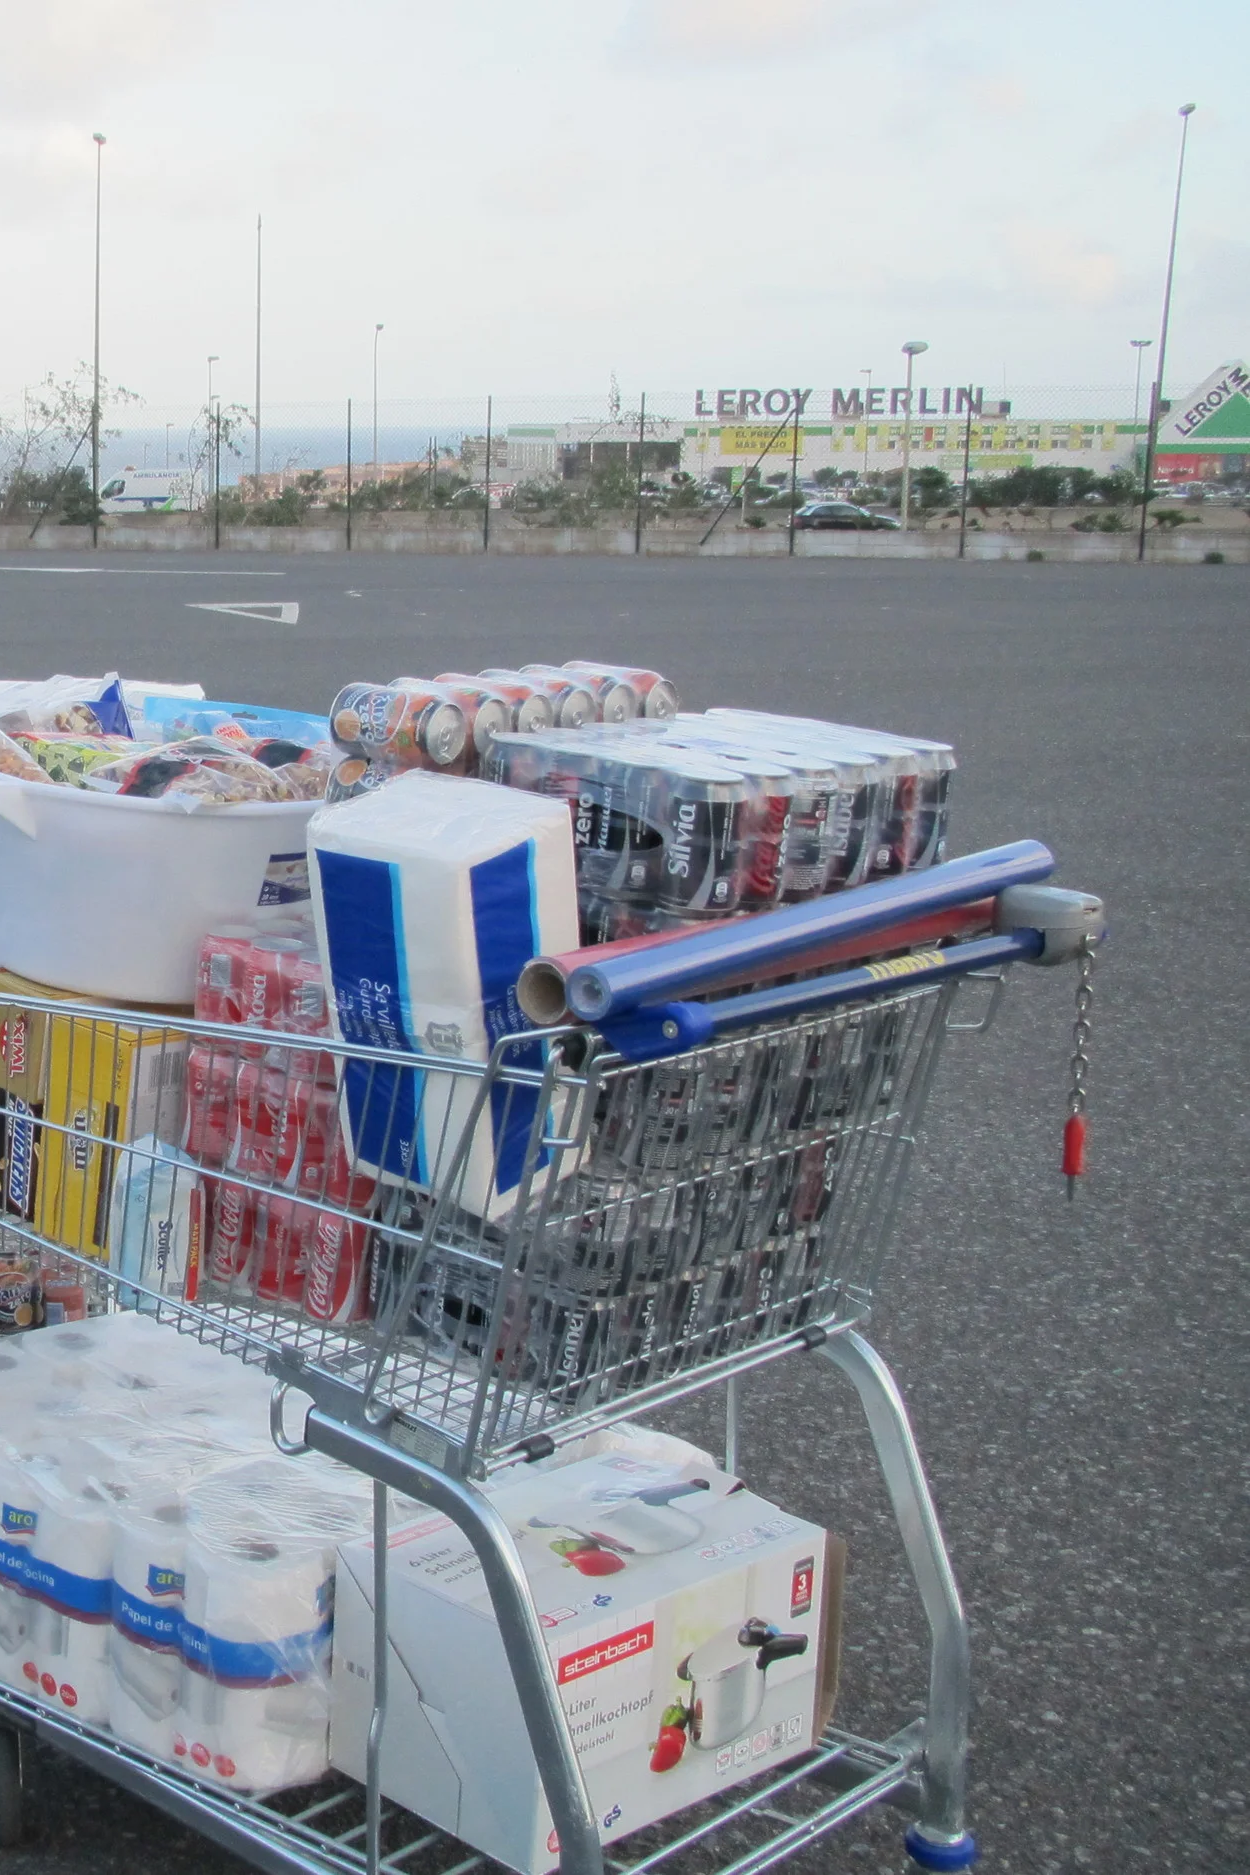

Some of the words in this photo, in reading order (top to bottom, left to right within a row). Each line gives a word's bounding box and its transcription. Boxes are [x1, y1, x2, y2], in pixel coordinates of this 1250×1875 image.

[695, 388, 813, 416] LEROY
[831, 387, 984, 415] MERLIN
[1174, 380, 1231, 436] LEROY
[575, 792, 594, 845] zero
[189, 1248, 198, 1268] PACK
[8, 1509, 34, 1527] aro
[6, 1554, 23, 1569] de
[408, 1547, 453, 1569] 6-Liter
[797, 1573, 807, 1591] 3
[121, 1601, 152, 1627] Papel
[154, 1617, 173, 1633] de
[564, 1631, 648, 1677] steinbach
[565, 1695, 598, 1718] -Liter
[569, 1689, 655, 1738] hnellkochtopf
[576, 1730, 616, 1756] delstahl
